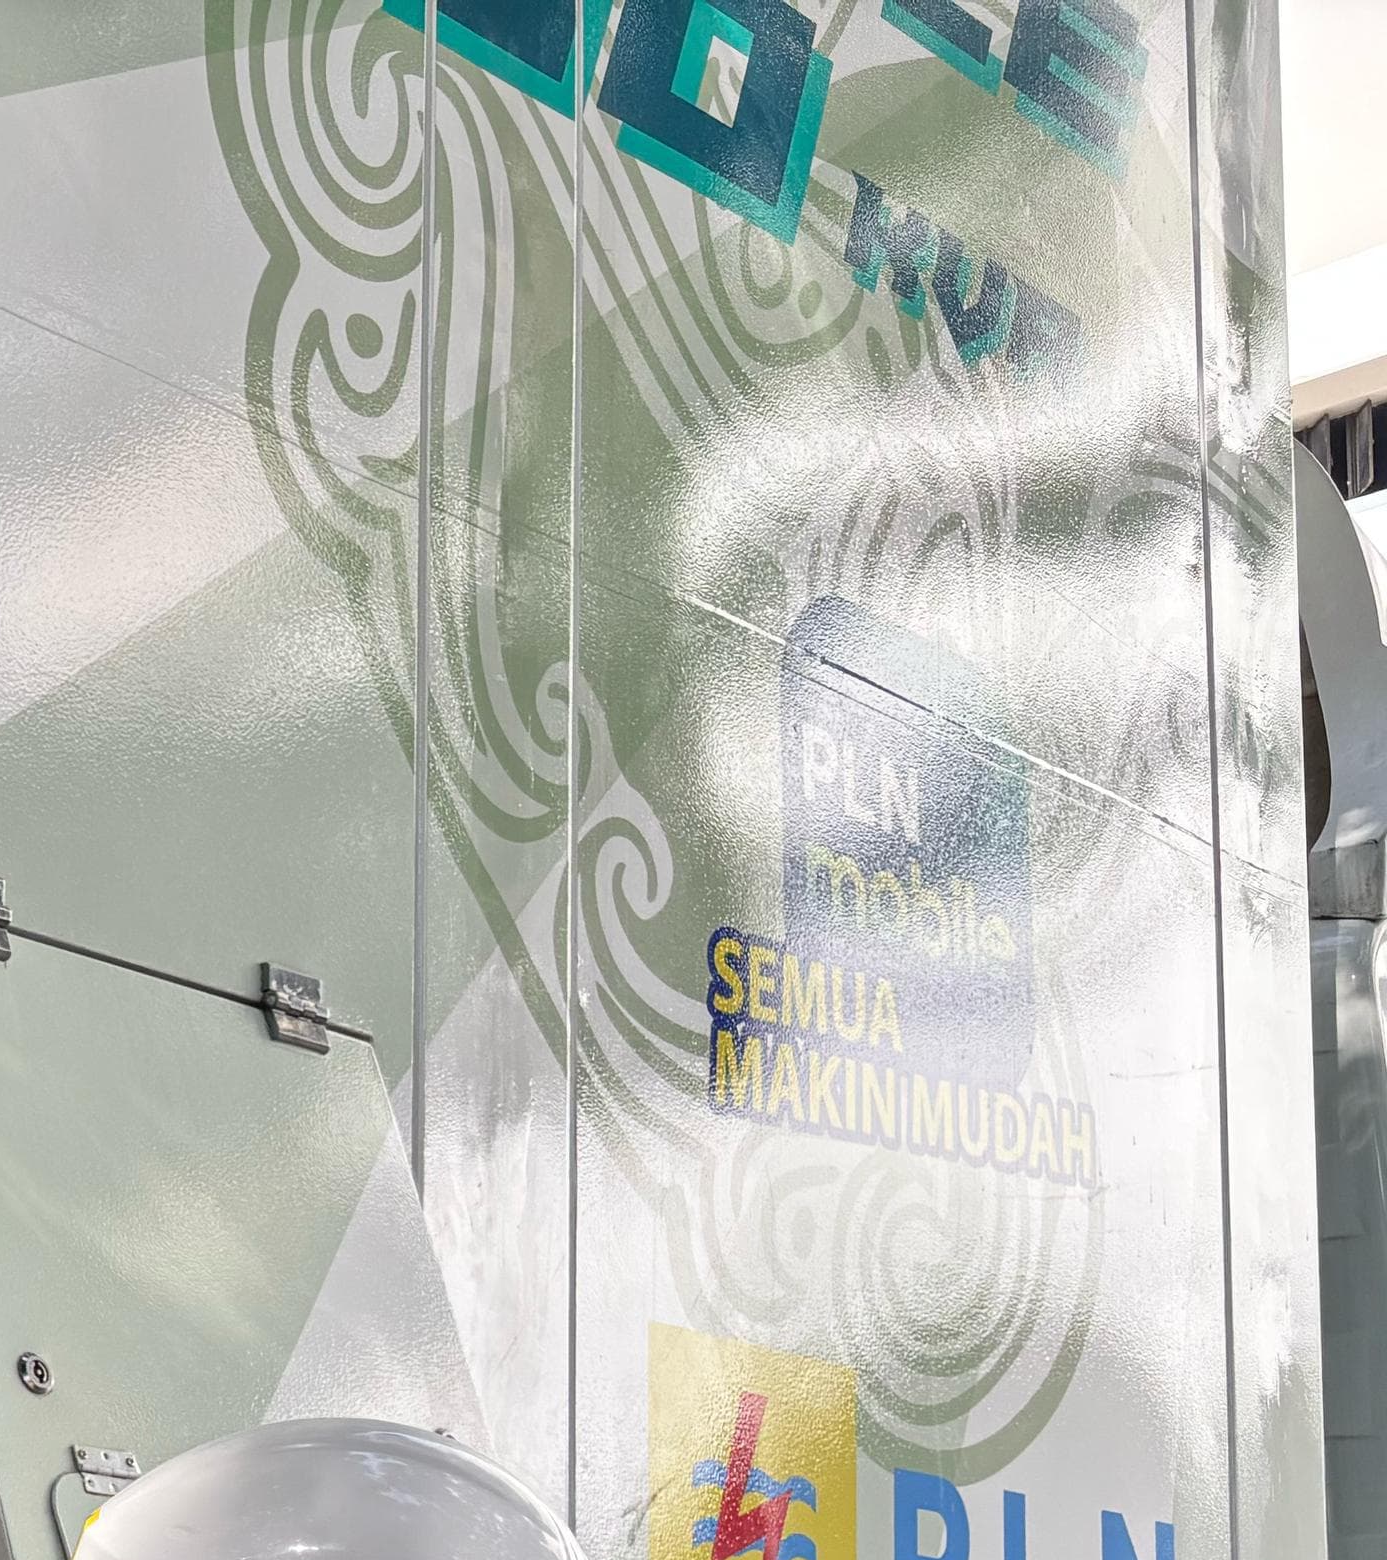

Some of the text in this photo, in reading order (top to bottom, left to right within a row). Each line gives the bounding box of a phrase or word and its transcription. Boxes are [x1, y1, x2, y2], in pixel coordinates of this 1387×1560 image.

[802, 722, 921, 843] PLN
[713, 935, 904, 1053] SEMUA
[715, 1029, 1096, 1178] MAKIN MUDAH
